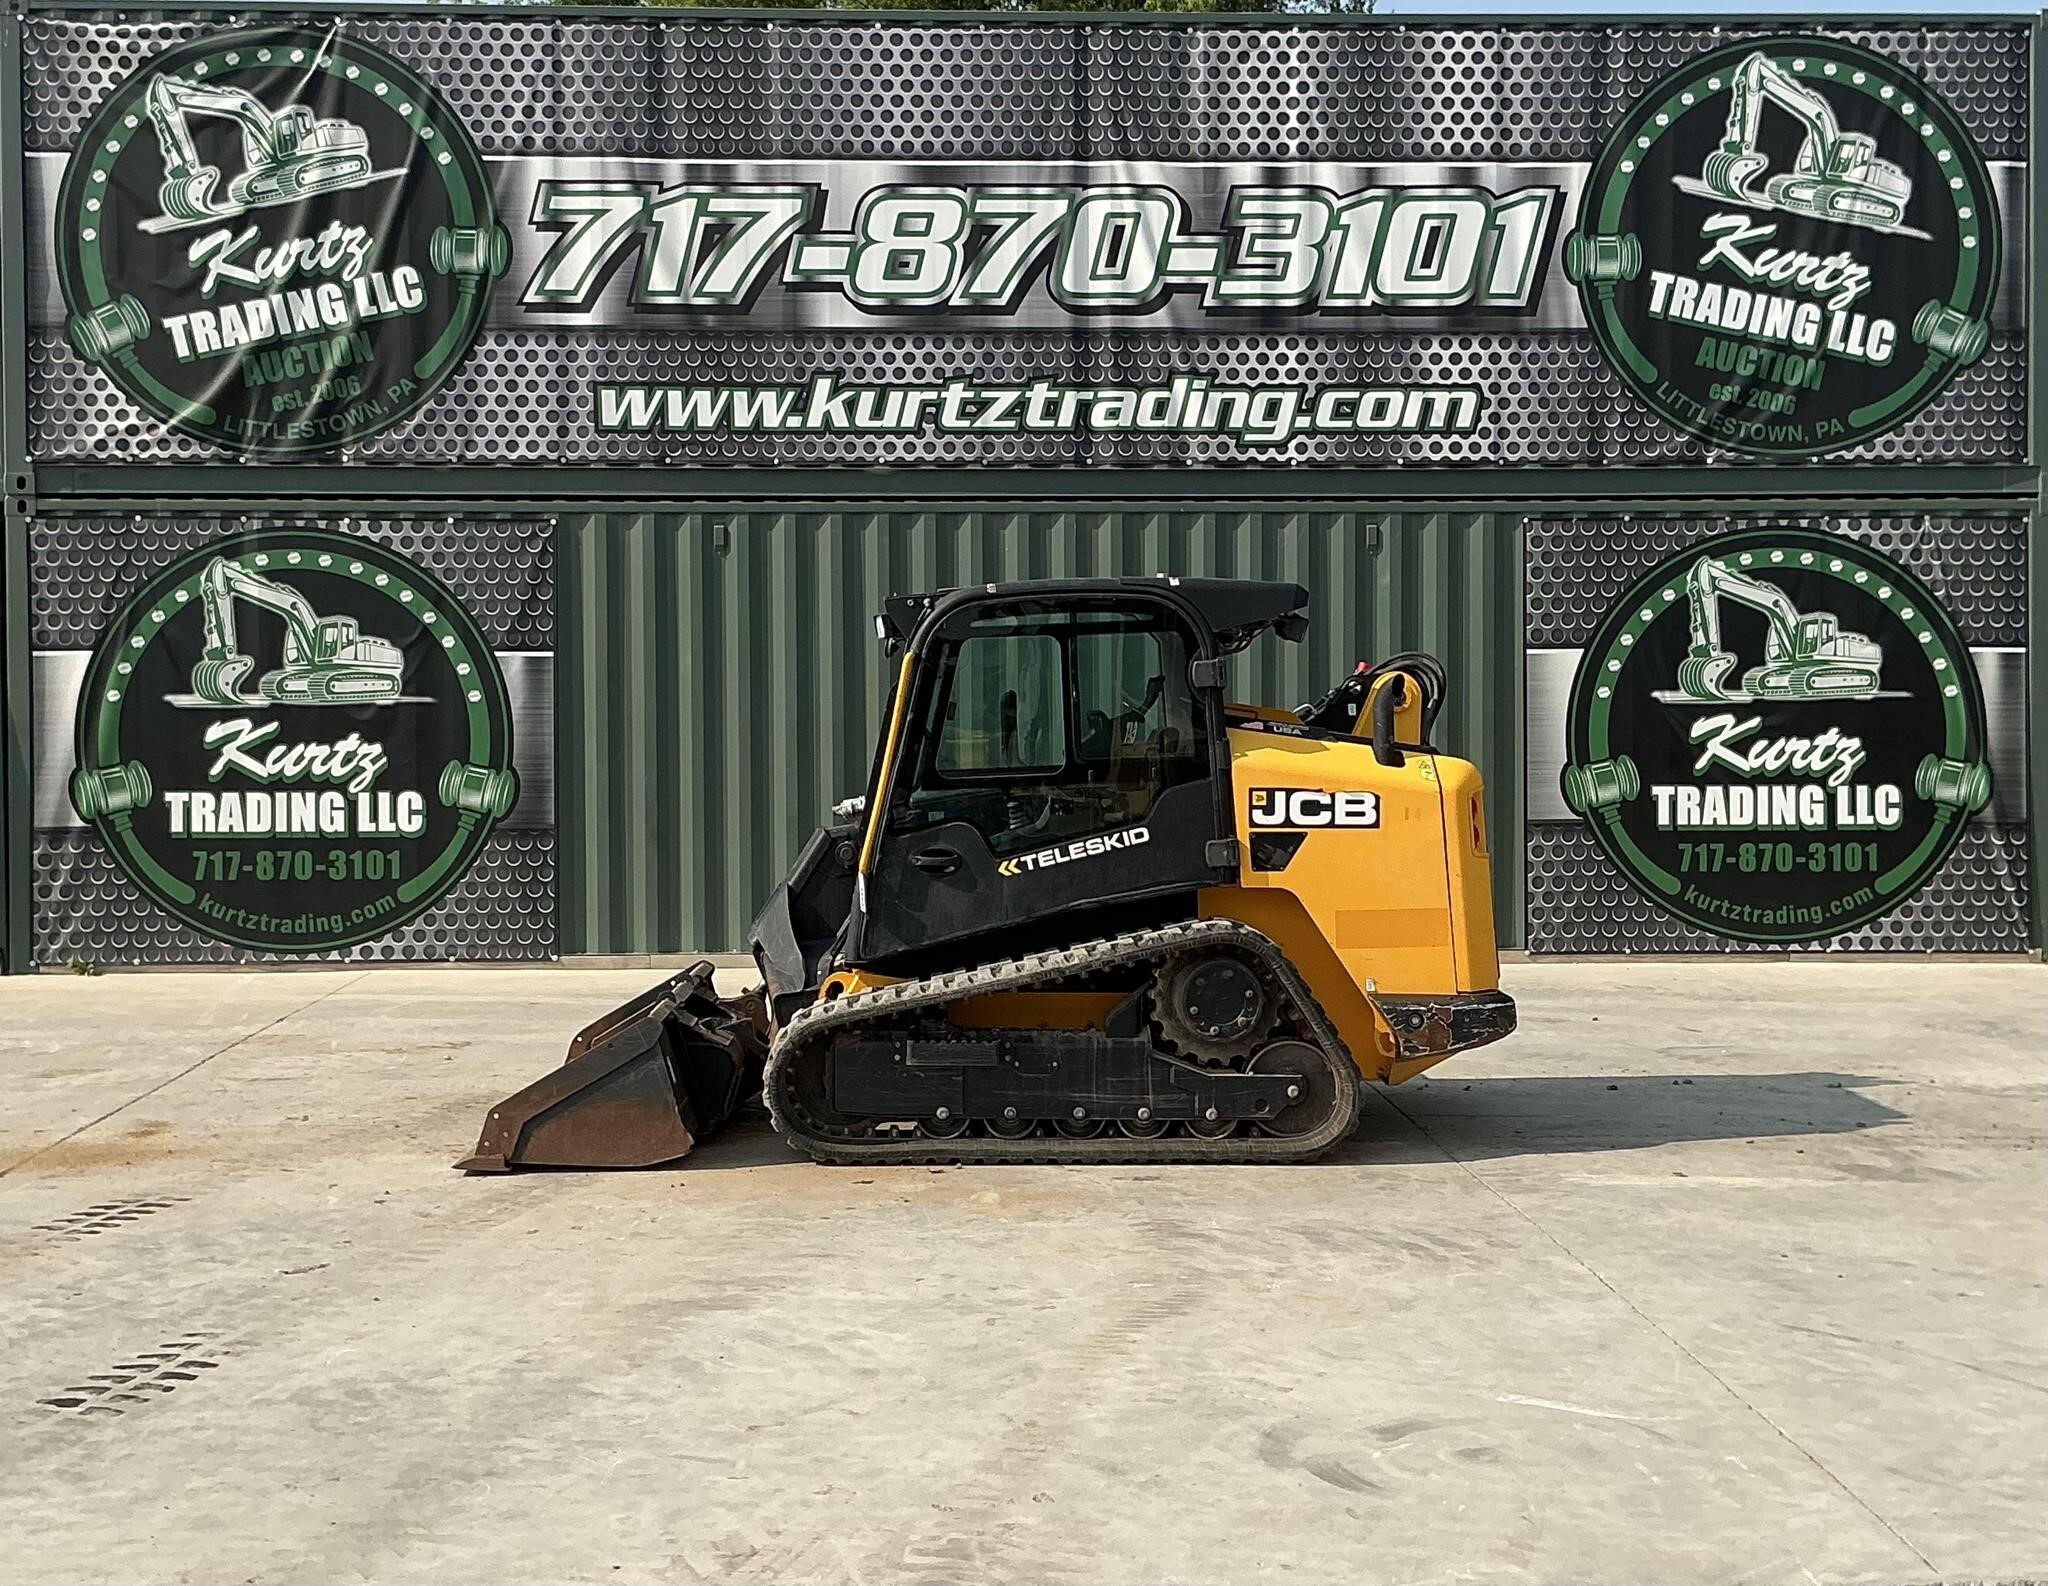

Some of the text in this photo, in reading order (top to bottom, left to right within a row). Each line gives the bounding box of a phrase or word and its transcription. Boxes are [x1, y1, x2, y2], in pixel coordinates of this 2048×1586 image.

[189, 220, 374, 294] Kurtz
[523, 181, 1566, 313] 717-870-3101
[1700, 213, 1871, 312] Kurtz
[162, 265, 426, 361] TRADING LLC
[1648, 270, 1899, 367] TRADING LLC
[243, 330, 375, 390] AUCTION
[1695, 336, 1827, 393] AUCTION
[222, 377, 420, 442] LITTLESTOWN, PA
[310, 375, 362, 405] 2006
[597, 374, 1483, 449] www.kurtztrading.com
[1655, 381, 1846, 444] LITTLESTOWN, PA
[1745, 388, 1797, 416] 2006
[204, 718, 388, 793] Kurtz
[1689, 713, 1867, 787] Kurtz
[164, 790, 426, 837] TRADING LLC
[1251, 790, 1377, 826] JCB
[1651, 784, 1903, 830] TRADING LLC
[192, 850, 401, 881] 717-870-3101
[1020, 826, 1150, 871] TELESKID
[1678, 842, 1880, 872] 717-870-3101
[198, 893, 397, 935] kurtztrading.com
[1684, 884, 1876, 926] kurtztrading.com
